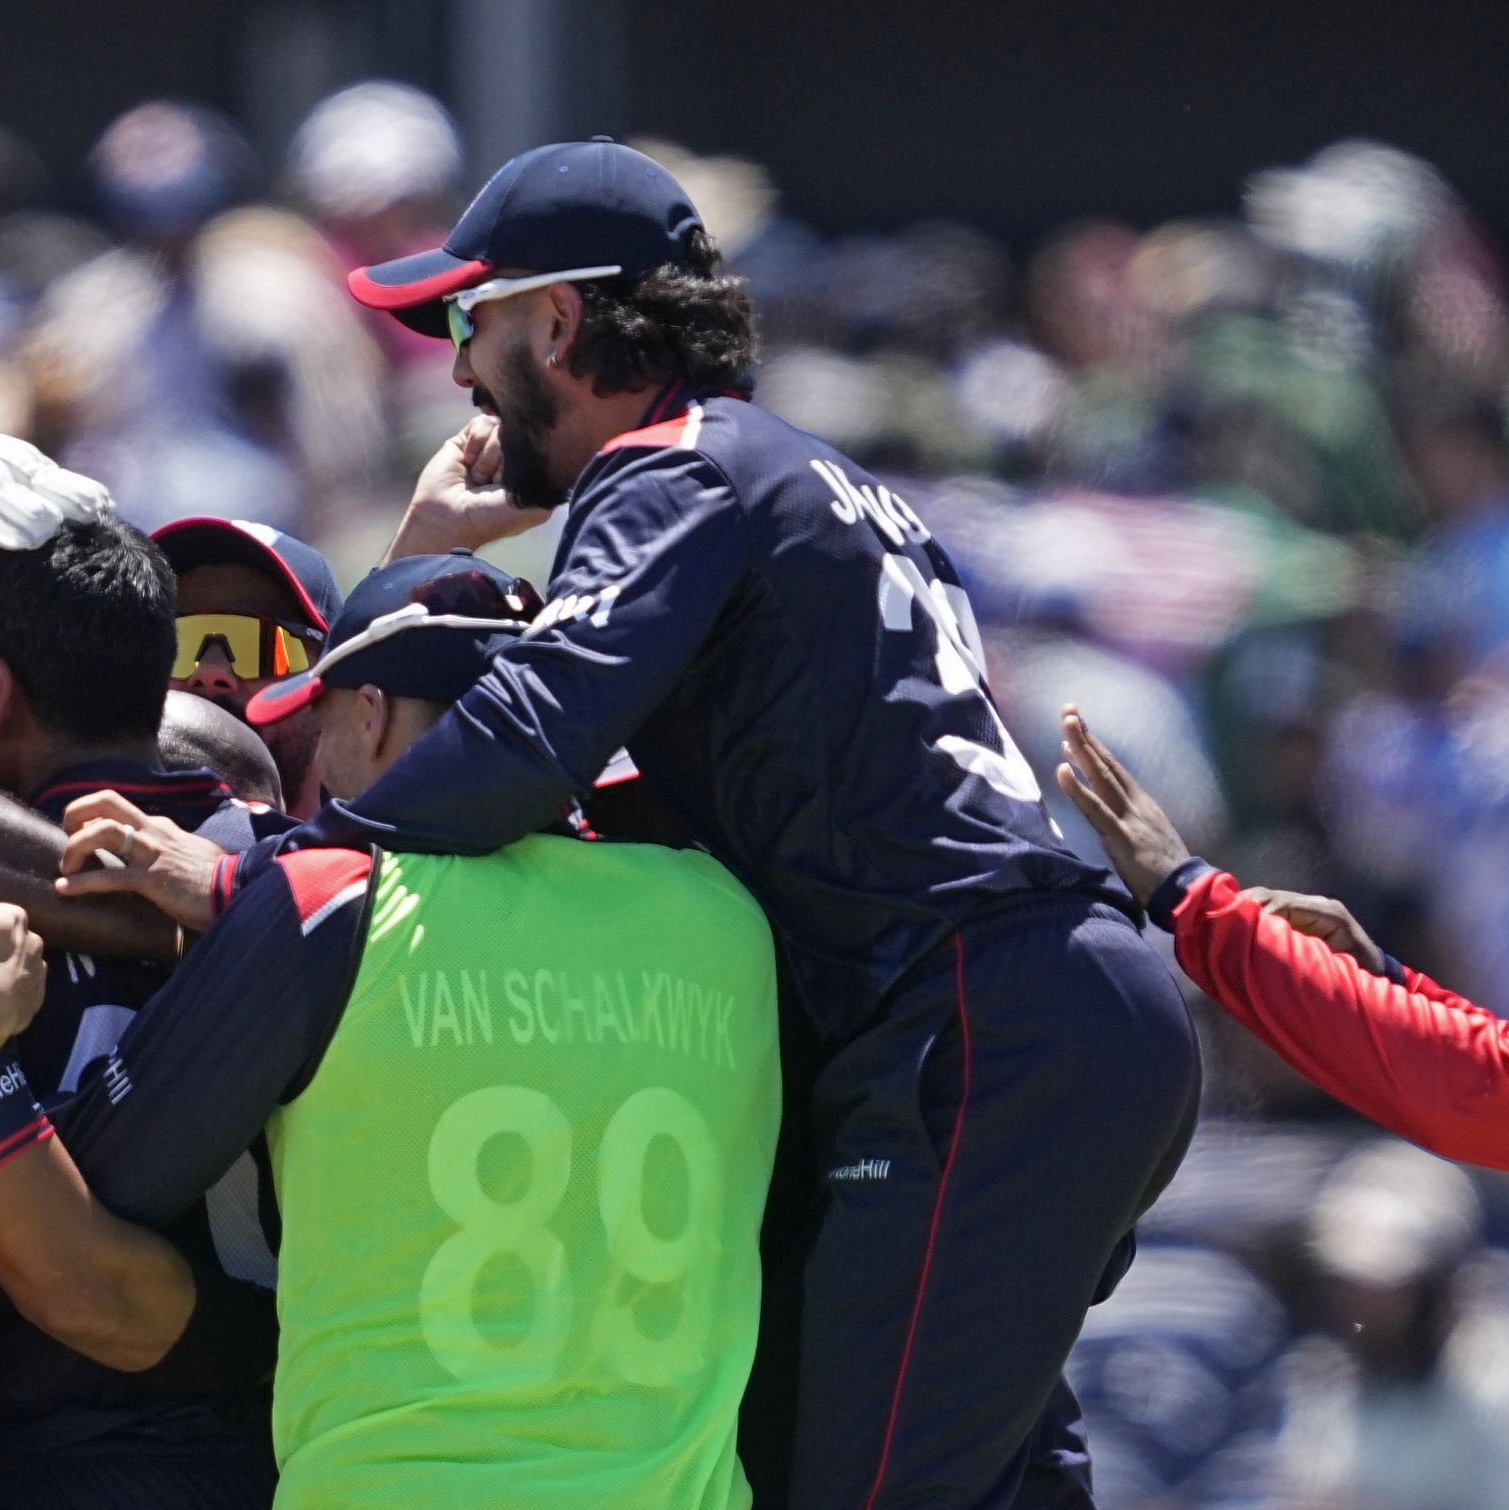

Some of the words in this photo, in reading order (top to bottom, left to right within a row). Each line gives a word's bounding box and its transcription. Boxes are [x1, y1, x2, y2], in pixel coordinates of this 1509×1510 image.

[399, 968, 492, 1048] VAN
[503, 968, 738, 1069] SCHALKWYK
[419, 1085, 721, 1387] 89
